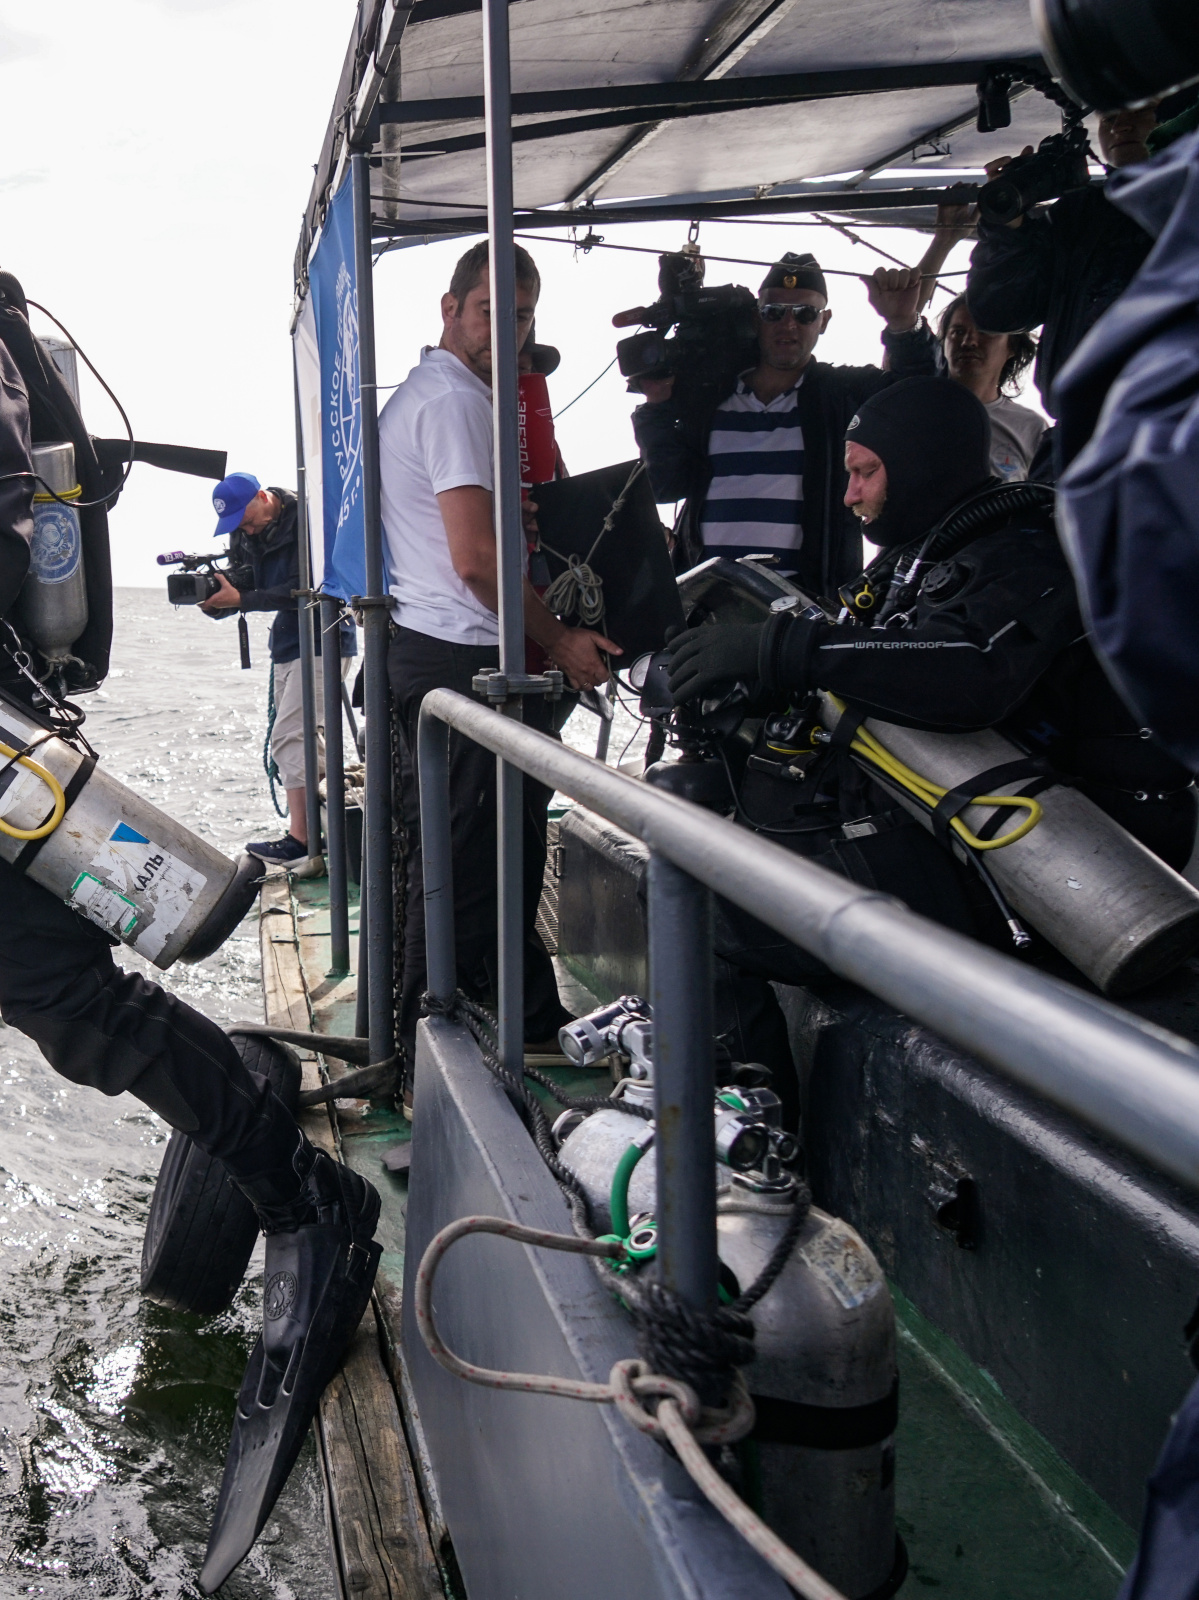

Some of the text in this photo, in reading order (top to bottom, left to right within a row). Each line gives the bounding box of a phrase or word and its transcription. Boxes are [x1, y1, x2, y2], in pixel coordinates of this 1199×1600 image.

[330, 351, 349, 480] РУССКОЕ
[518, 401, 531, 473] ЗВЕЗДА
[855, 641, 943, 649] WATERPROOF
